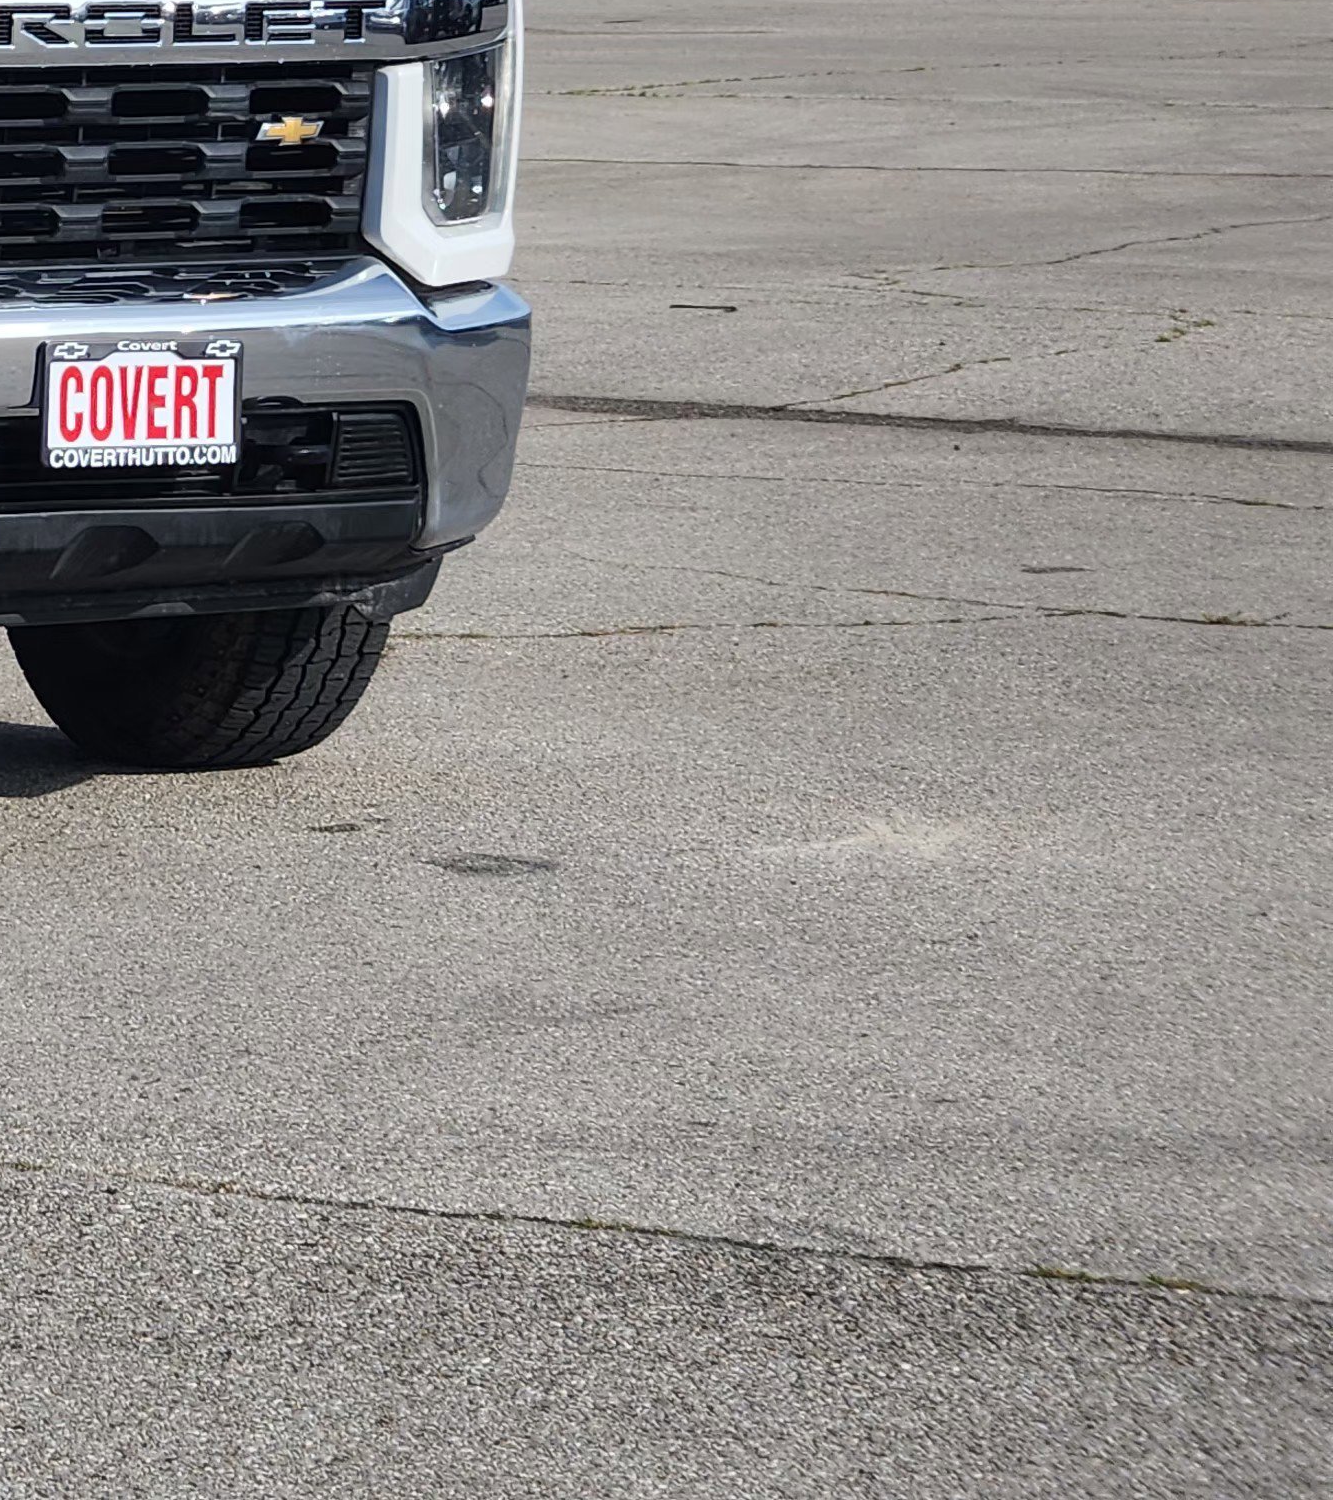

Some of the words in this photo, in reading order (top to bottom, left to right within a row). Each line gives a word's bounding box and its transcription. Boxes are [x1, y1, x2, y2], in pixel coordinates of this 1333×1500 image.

[116, 339, 178, 351] Covert
[59, 364, 224, 442] COVERT
[49, 445, 237, 469] COVERTHUTTO.COM
